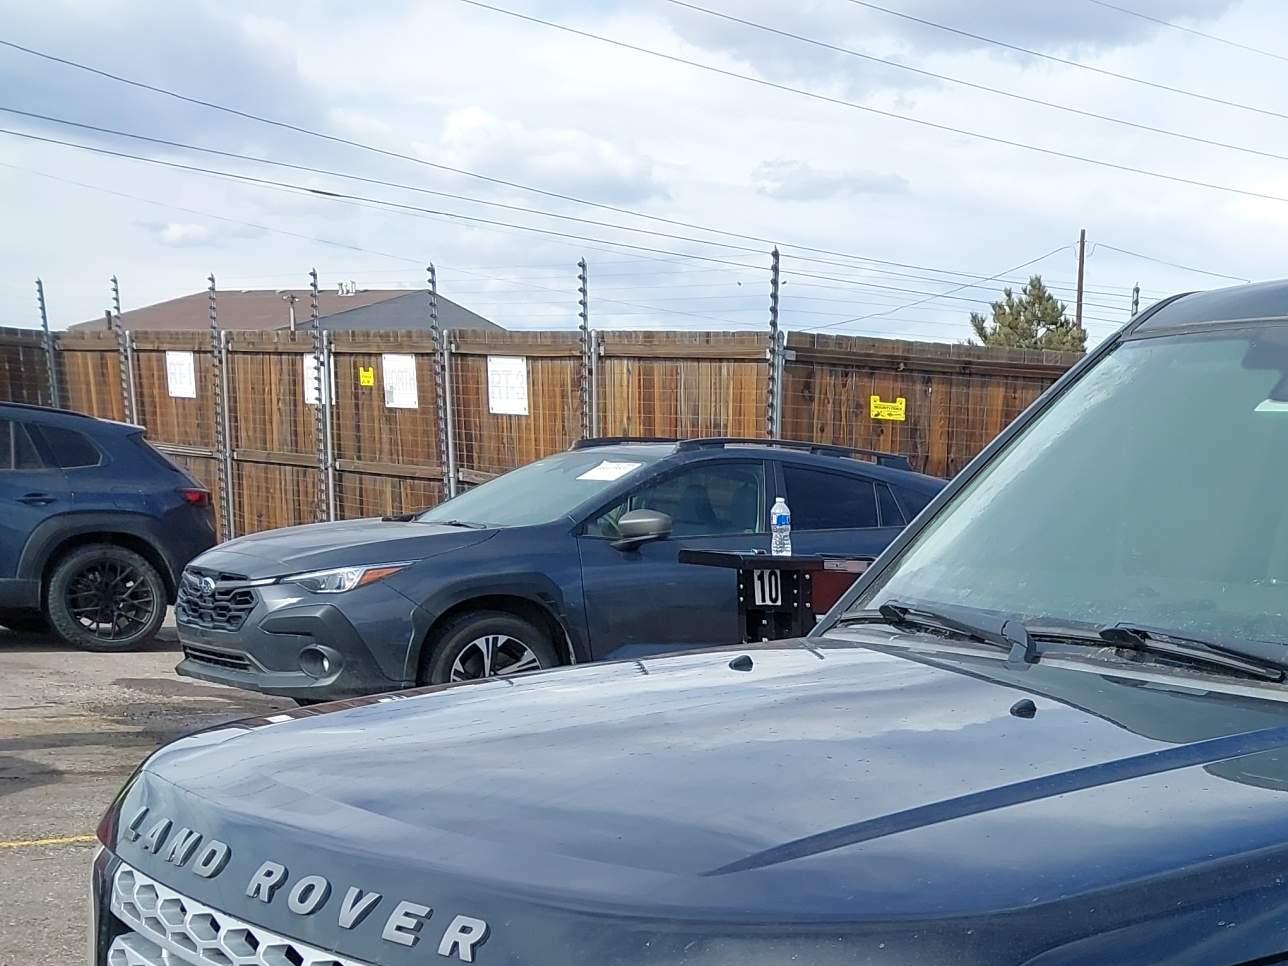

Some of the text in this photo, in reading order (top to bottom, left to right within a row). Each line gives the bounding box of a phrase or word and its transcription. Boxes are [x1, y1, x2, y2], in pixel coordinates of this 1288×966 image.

[756, 569, 779, 604] 10
[124, 806, 489, 963] LAND ROVER
